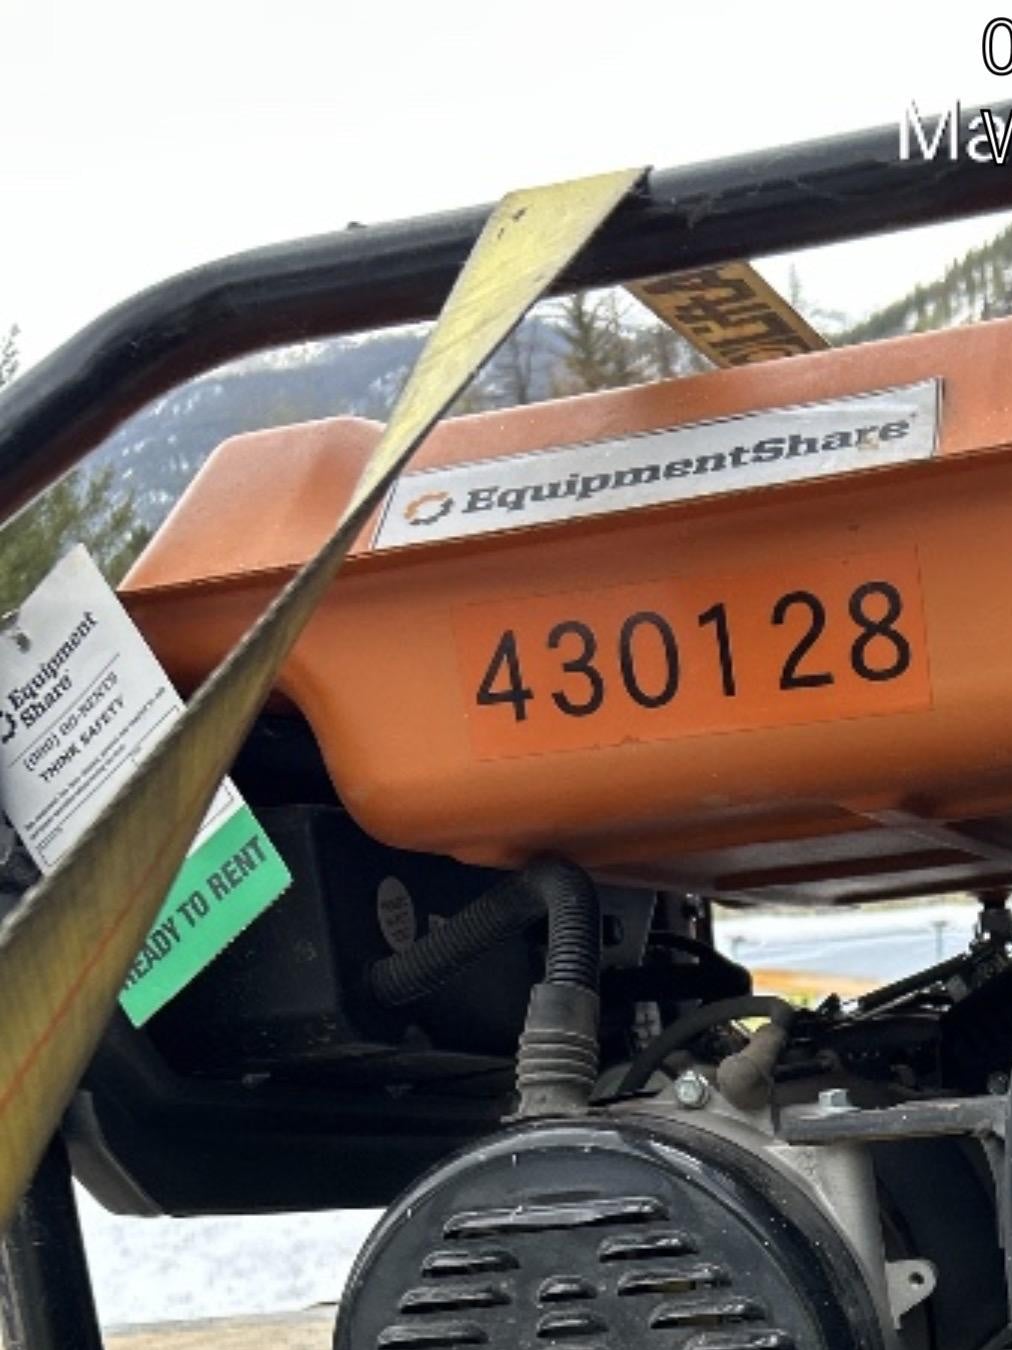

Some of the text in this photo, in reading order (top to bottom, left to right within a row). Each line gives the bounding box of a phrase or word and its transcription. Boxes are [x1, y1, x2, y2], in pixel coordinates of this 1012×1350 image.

[461, 415, 913, 513] EquipmentShare
[8, 611, 98, 710] Equipment
[477, 581, 911, 722] 430128
[19, 674, 73, 730] Share
[38, 695, 126, 784] THINK SAFETY
[177, 890, 210, 930] TO
[207, 835, 268, 895] RENT
